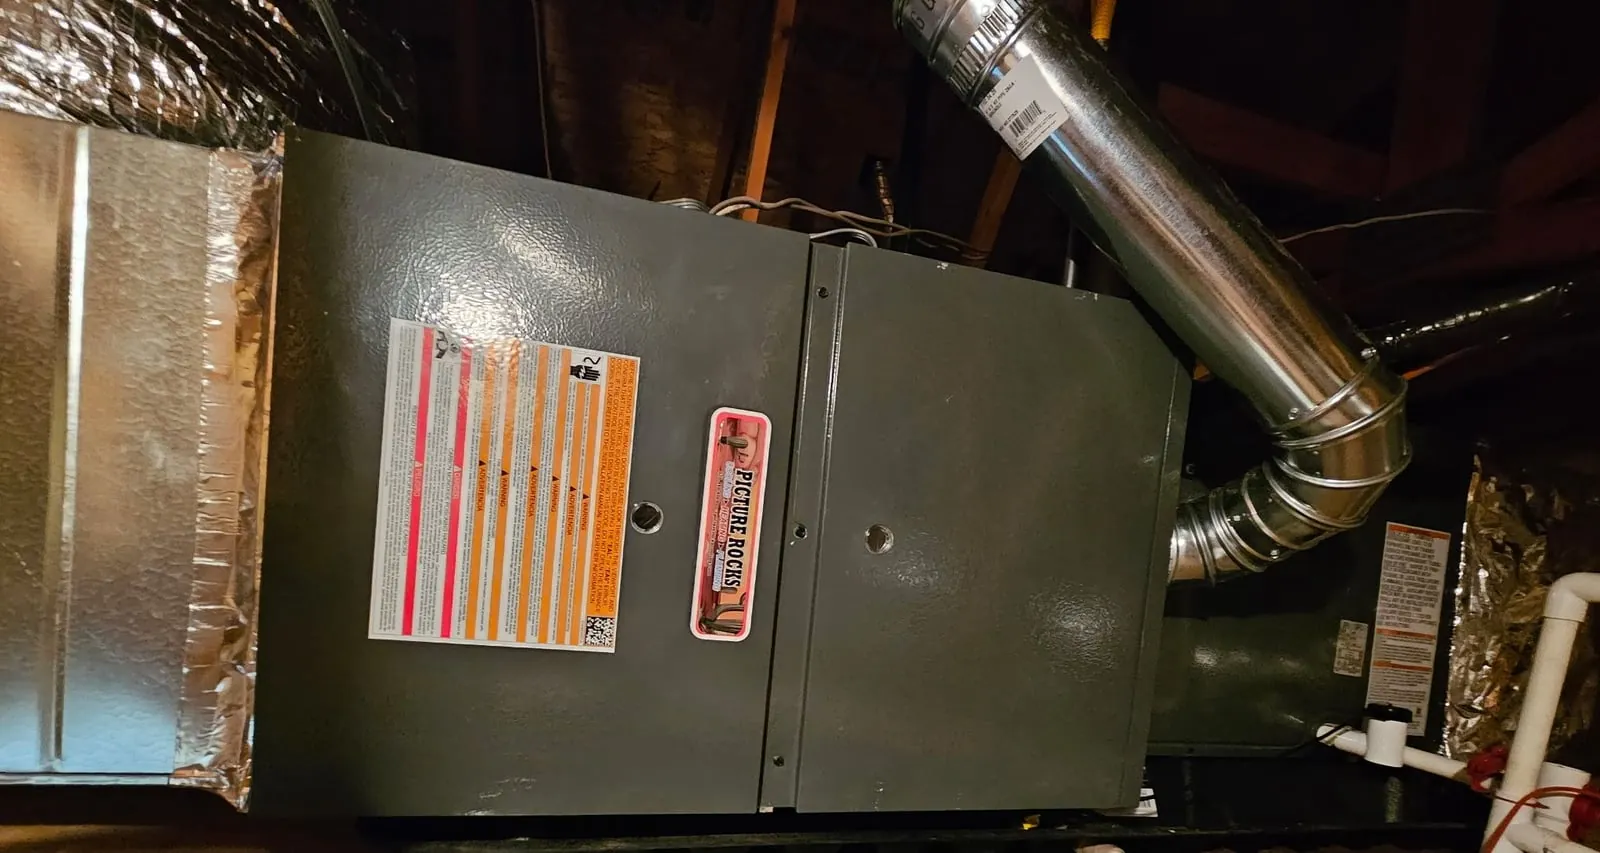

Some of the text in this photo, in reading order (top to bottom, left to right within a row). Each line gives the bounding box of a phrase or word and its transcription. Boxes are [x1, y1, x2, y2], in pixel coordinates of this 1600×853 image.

[610, 397, 618, 427] CONTROL
[615, 418, 623, 447] CONTROL
[476, 467, 485, 511] ADVERTENCIA
[499, 477, 507, 507] WARNING
[528, 473, 537, 517] ADVERTENCIA
[550, 483, 558, 512] WARNING
[566, 493, 575, 536] ADVERTENCIA
[580, 500, 588, 530] WARNING
[717, 506, 727, 541] HEATING
[724, 470, 752, 587] PICTURE ROCKS
